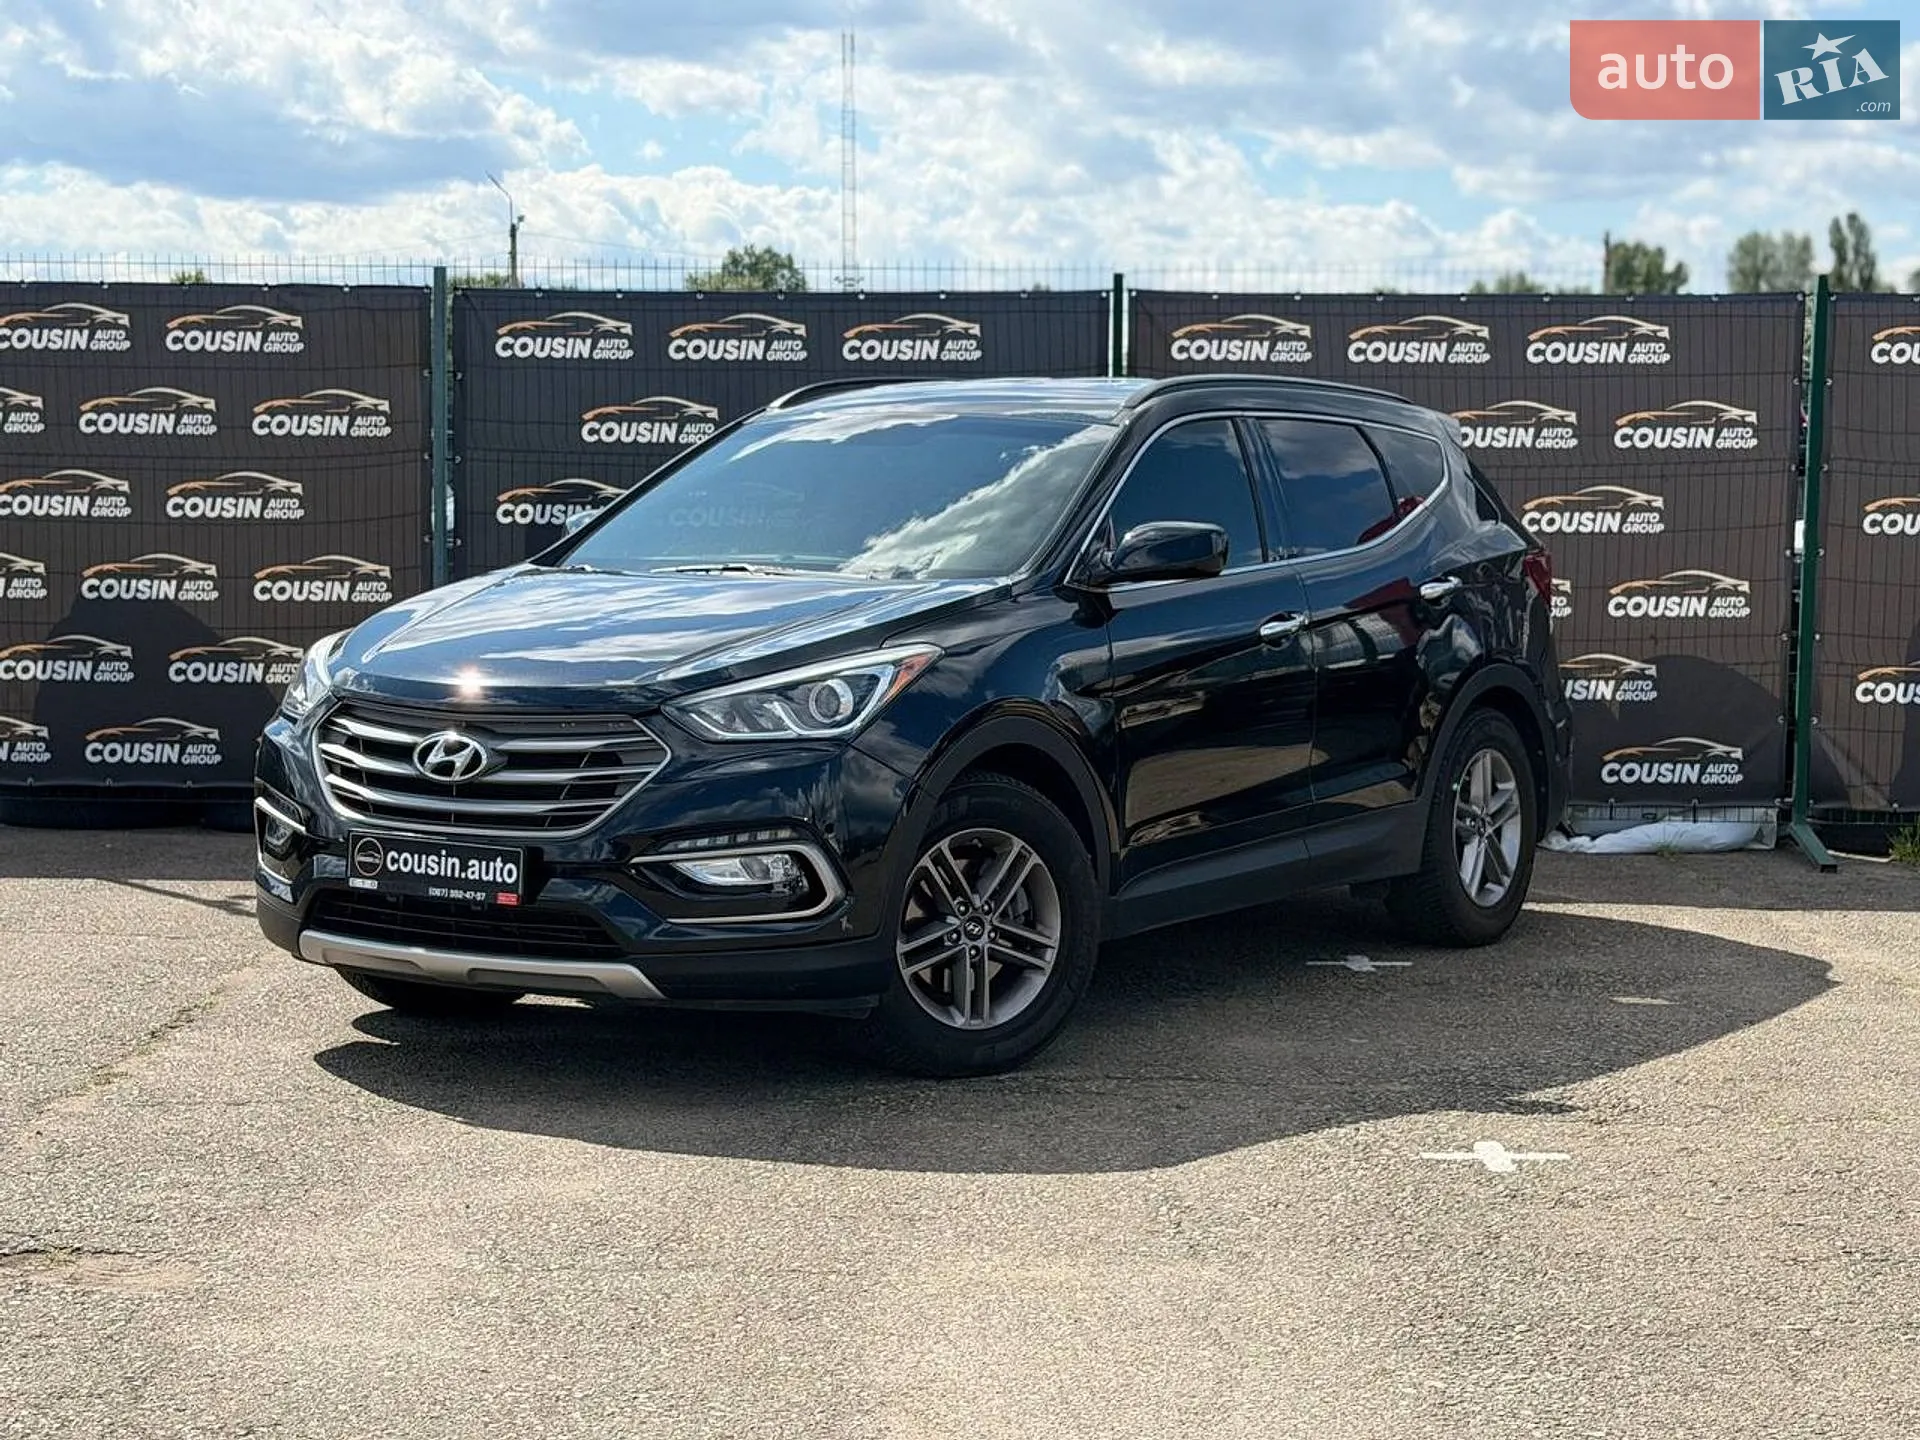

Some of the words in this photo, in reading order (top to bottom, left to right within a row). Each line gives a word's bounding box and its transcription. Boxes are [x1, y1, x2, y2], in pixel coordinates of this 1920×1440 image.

[0, 328, 89, 350] COUSIN
[93, 330, 126, 340] AUTO
[166, 330, 261, 352] COUSIN
[267, 332, 300, 343] AUTO
[89, 341, 131, 351] GROUP
[263, 342, 304, 353] GROUP
[495, 336, 591, 359] COUSIN
[597, 338, 628, 348] AUTO
[668, 337, 764, 360] COUSIN
[770, 340, 802, 350] AUTO
[842, 338, 938, 361] COUSIN
[945, 340, 976, 350] AUTO
[1170, 338, 1268, 362] COUSIN
[1273, 341, 1307, 352] AUTO
[592, 348, 634, 360] GROUP
[766, 350, 807, 361] GROUP
[940, 350, 982, 361] GROUP
[1269, 351, 1313, 363] GROUP
[1347, 341, 1445, 364] COUSIN
[1451, 343, 1485, 354] AUTO
[1526, 341, 1625, 365] COUSIN
[1630, 343, 1666, 354] AUTO
[1446, 353, 1491, 365] GROUP
[1626, 353, 1671, 366] GROUP
[8, 412, 40, 422] AUTO
[79, 412, 175, 434] COUSIN
[180, 415, 213, 425] AUTO
[3, 423, 46, 433] GROUP
[176, 424, 218, 436] GROUP
[252, 415, 349, 437] COUSIN
[354, 416, 387, 427] AUTO
[350, 426, 392, 438] GROUP
[581, 421, 677, 444] COUSIN
[683, 423, 714, 433] AUTO
[1460, 426, 1535, 448] OUSIN
[1539, 428, 1573, 438] AUTO
[1613, 425, 1713, 449] COUSIN
[1718, 428, 1752, 439] AUTO
[1535, 438, 1579, 449] GROUP
[1714, 438, 1759, 449] GROUP
[0, 494, 90, 517] COUSIN
[95, 496, 127, 507] AUTO
[166, 496, 261, 519] COUSIN
[267, 498, 300, 508] AUTO
[90, 506, 132, 518] GROUP
[263, 508, 305, 519] GROUP
[496, 502, 592, 525] COUS
[1521, 510, 1621, 534] COUSIN
[1626, 512, 1660, 523] AUTO
[1622, 522, 1665, 535] GROUP
[11, 578, 42, 588] AUTO
[81, 578, 177, 600] COUSIN
[182, 580, 214, 590] AUTO
[6, 588, 48, 599] GROUP
[178, 590, 219, 601] GROUP
[253, 579, 350, 602] COUSIN
[355, 581, 388, 592] AUTO
[351, 591, 393, 602] GROUP
[1607, 596, 1707, 618] COUSIN
[1712, 597, 1747, 608] AUTO
[1707, 607, 1751, 619] GROUP
[0, 660, 93, 681] COUSIN
[98, 661, 130, 672] AUTO
[168, 661, 265, 683] COUSIN
[93, 672, 135, 682] GROUP
[1619, 680, 1653, 691] AUTO
[1615, 691, 1658, 701] GROUP
[15, 742, 46, 752] AUTO
[85, 741, 180, 763] COUSIN
[186, 744, 216, 754] AUTO
[10, 752, 52, 762] GROUP
[181, 754, 222, 765] GROUP
[1601, 762, 1700, 784] COUSIN
[1705, 763, 1739, 774] AUTO
[1700, 774, 1744, 785] GROUP
[386, 850, 518, 884] cousin.auto
